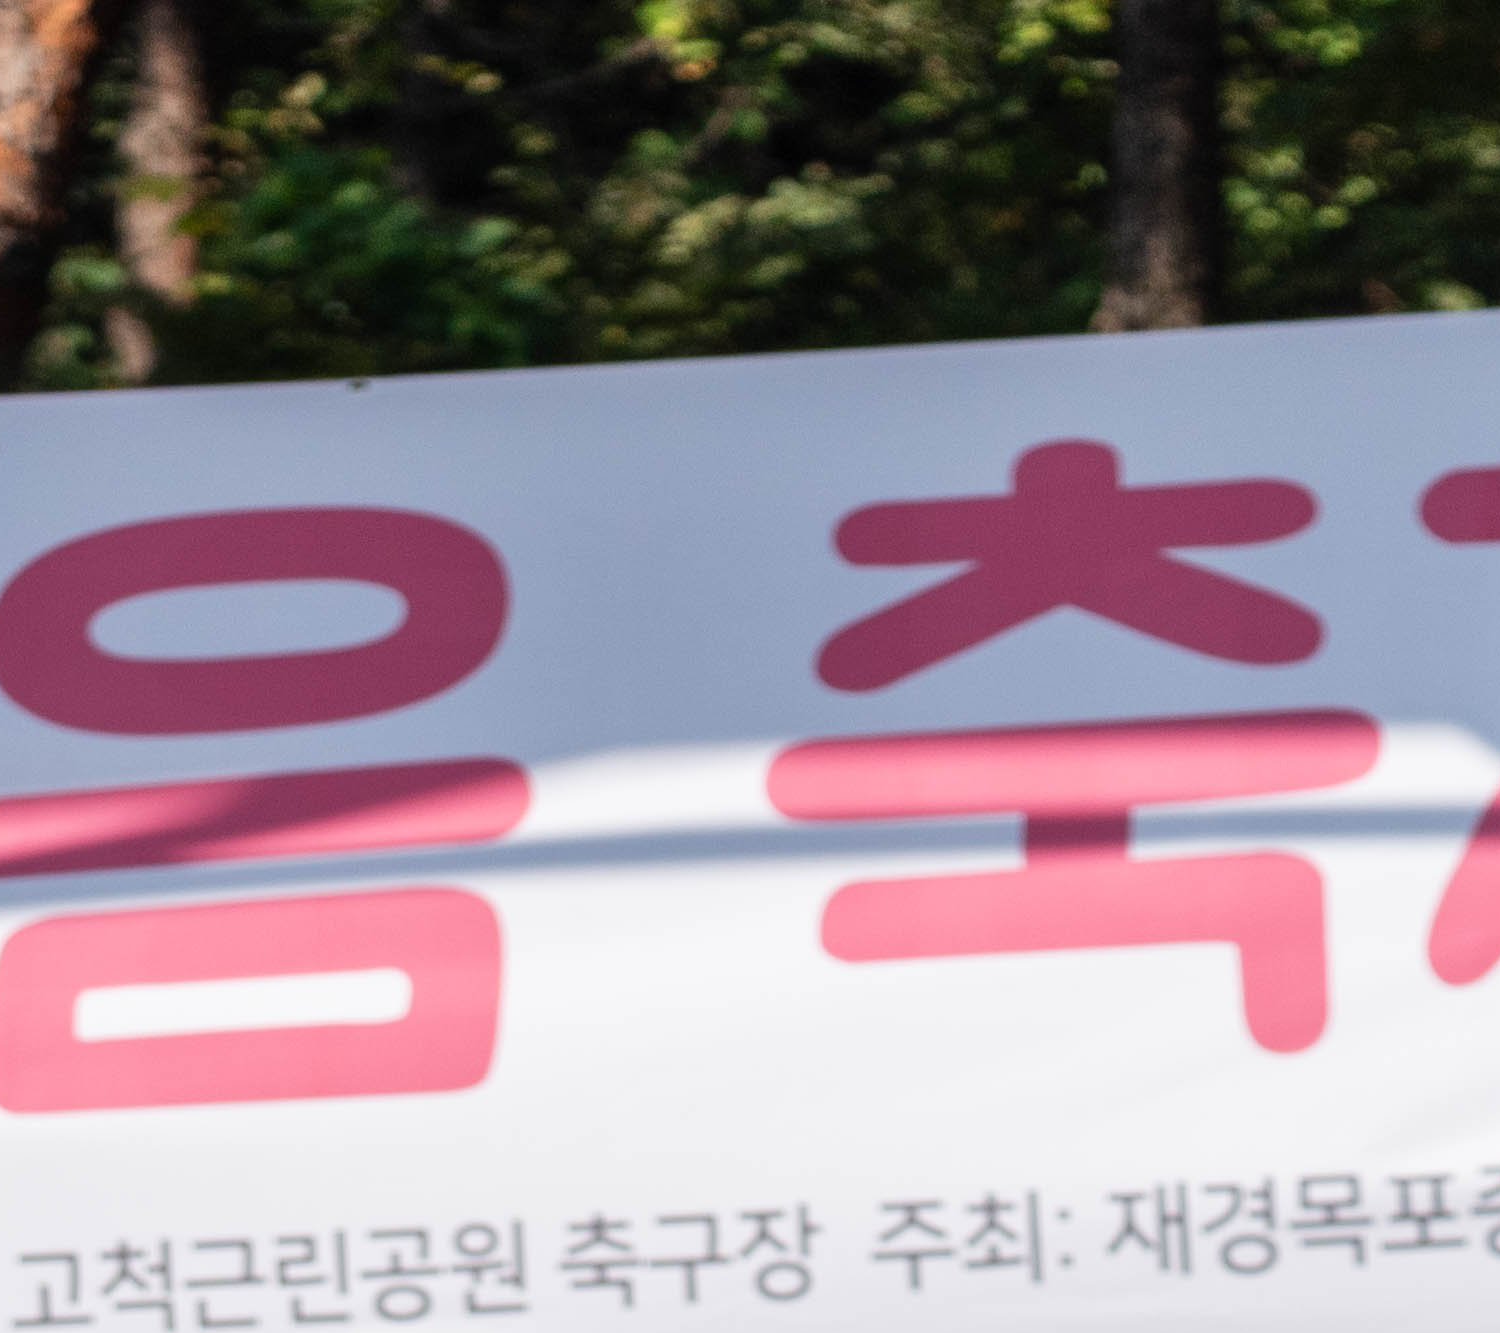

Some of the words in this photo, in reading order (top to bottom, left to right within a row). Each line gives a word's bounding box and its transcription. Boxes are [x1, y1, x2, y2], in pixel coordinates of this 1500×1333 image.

[12, 1219, 529, 1333] 고척근린공원
[558, 1204, 821, 1309] 축구장
[871, 1190, 1074, 1292] 주최:
